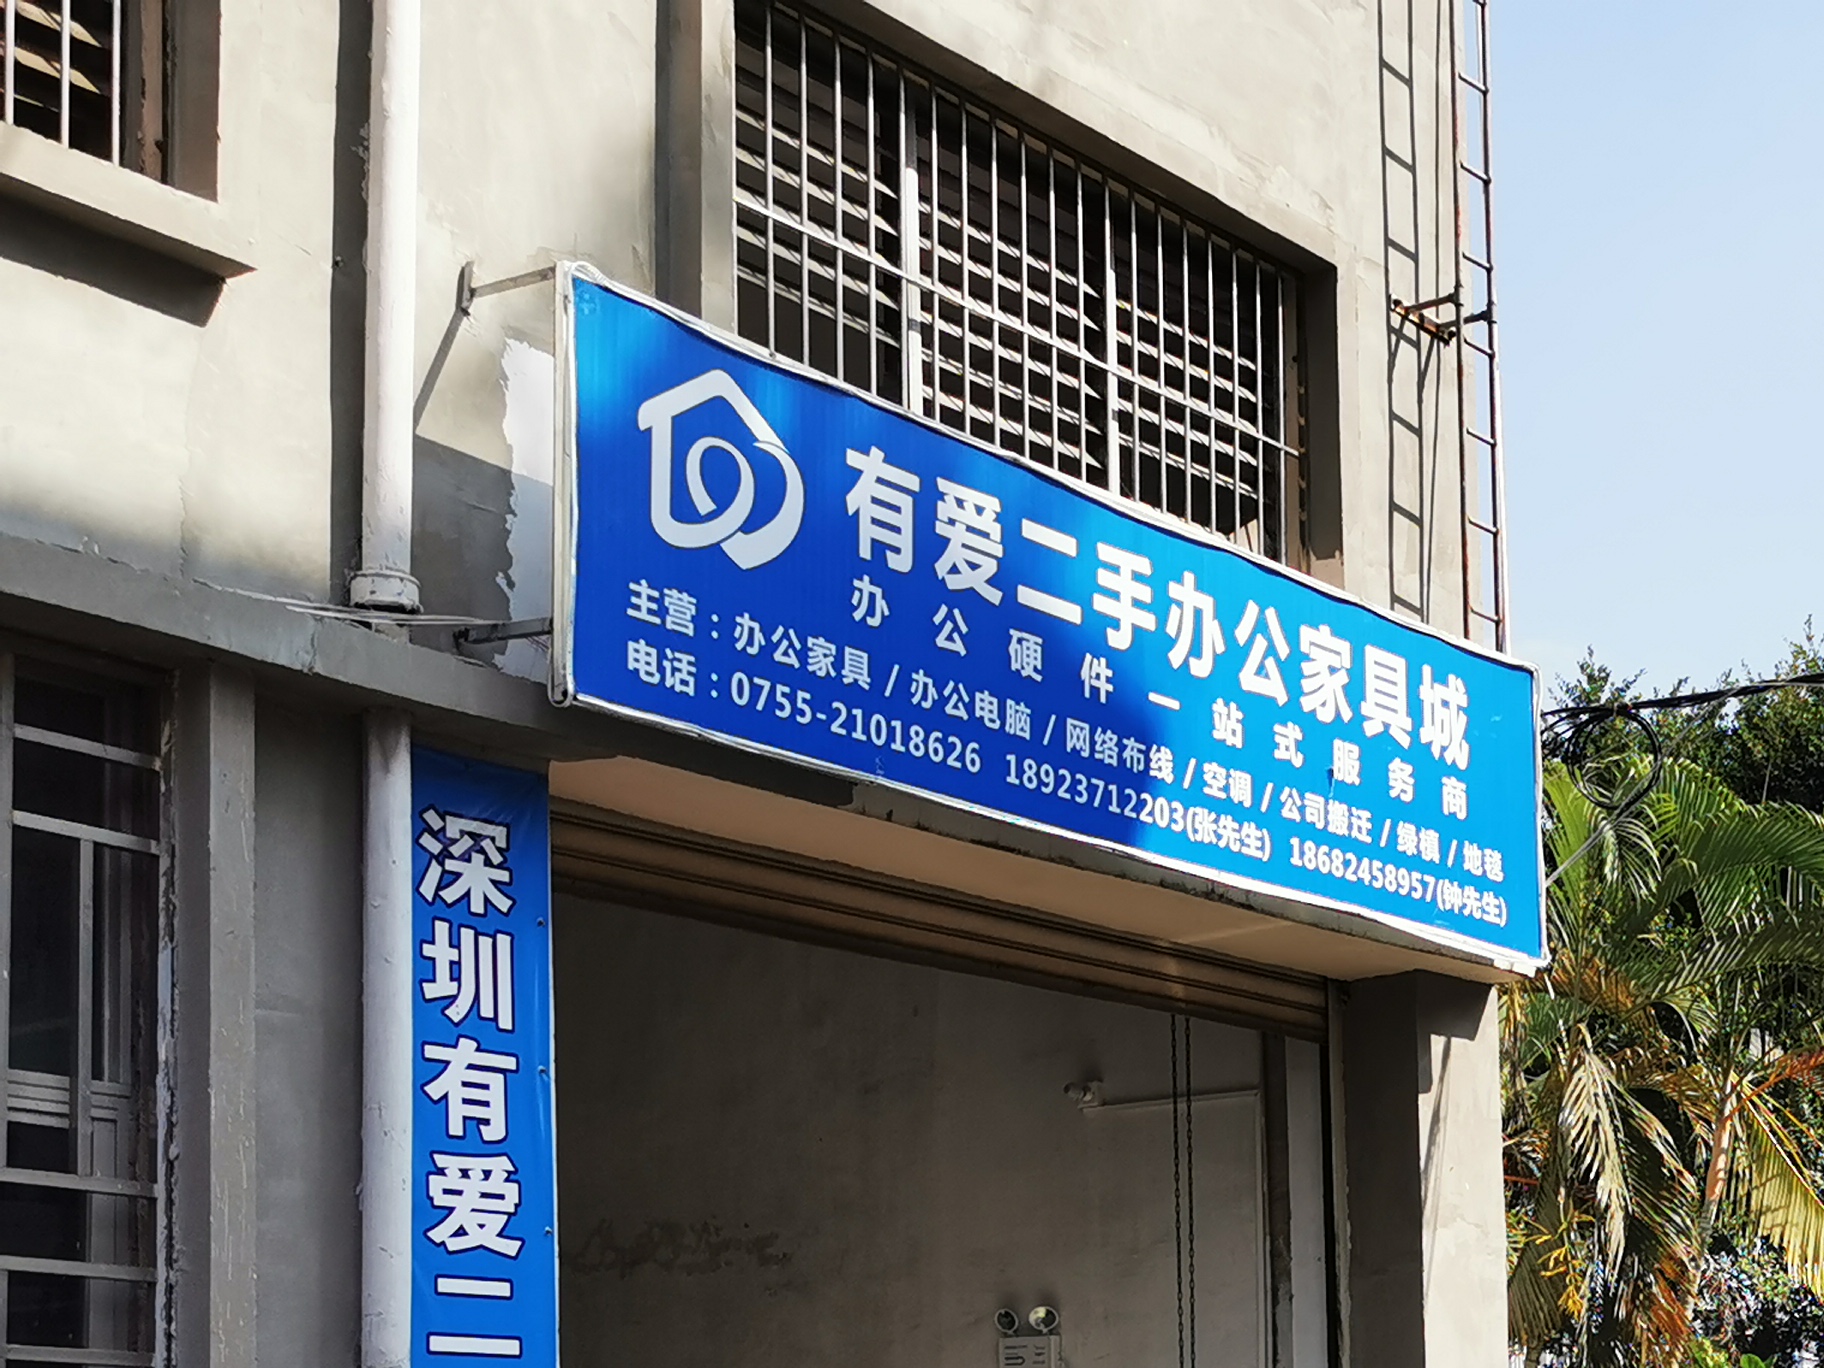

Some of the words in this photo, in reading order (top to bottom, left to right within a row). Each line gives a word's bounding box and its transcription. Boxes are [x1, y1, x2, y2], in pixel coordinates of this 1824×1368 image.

[845, 445, 1469, 771] 有爱二手办公家具城
[851, 574, 1468, 820] 办公硬件一站式服务商
